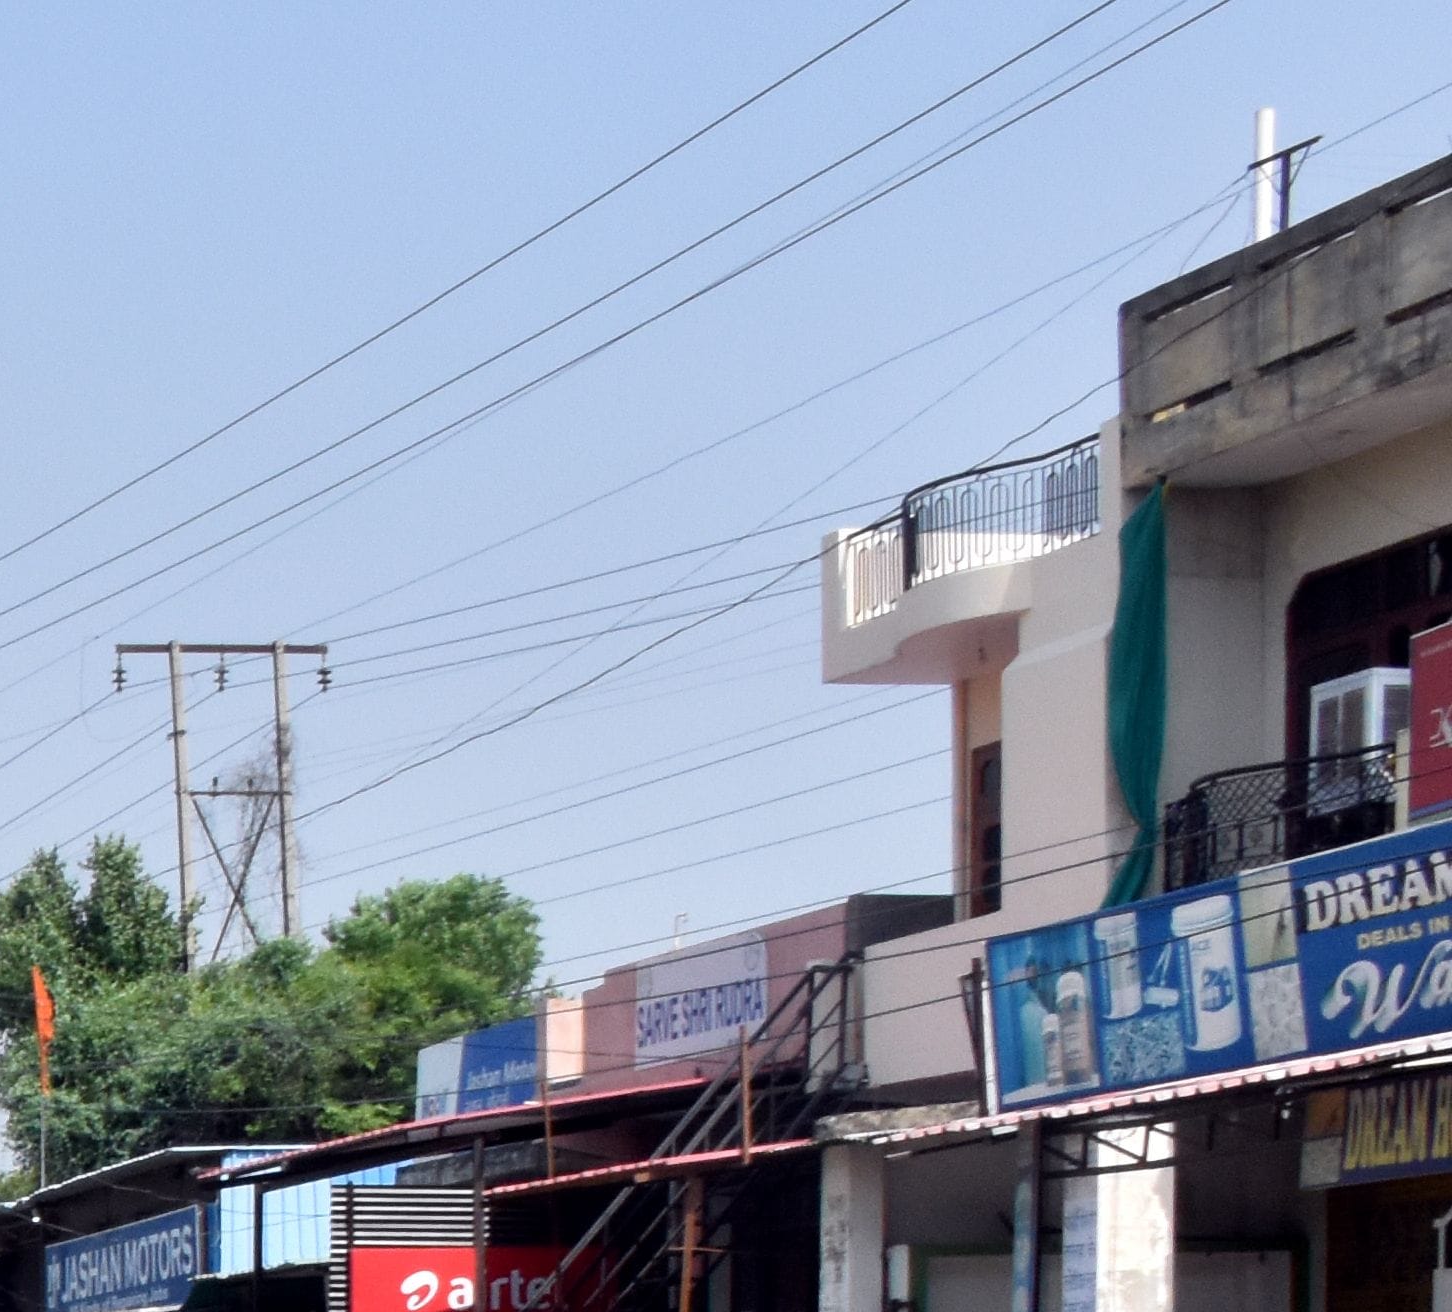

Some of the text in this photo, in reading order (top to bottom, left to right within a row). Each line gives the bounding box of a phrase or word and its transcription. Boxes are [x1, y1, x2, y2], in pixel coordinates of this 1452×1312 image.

[1357, 916, 1451, 951] DEALS IN
[637, 977, 764, 1048] SARVE SHRI RUDRA
[1344, 1079, 1428, 1170] DREAM
[61, 1243, 123, 1304] JASHAN
[124, 1225, 193, 1287] MOTORS
